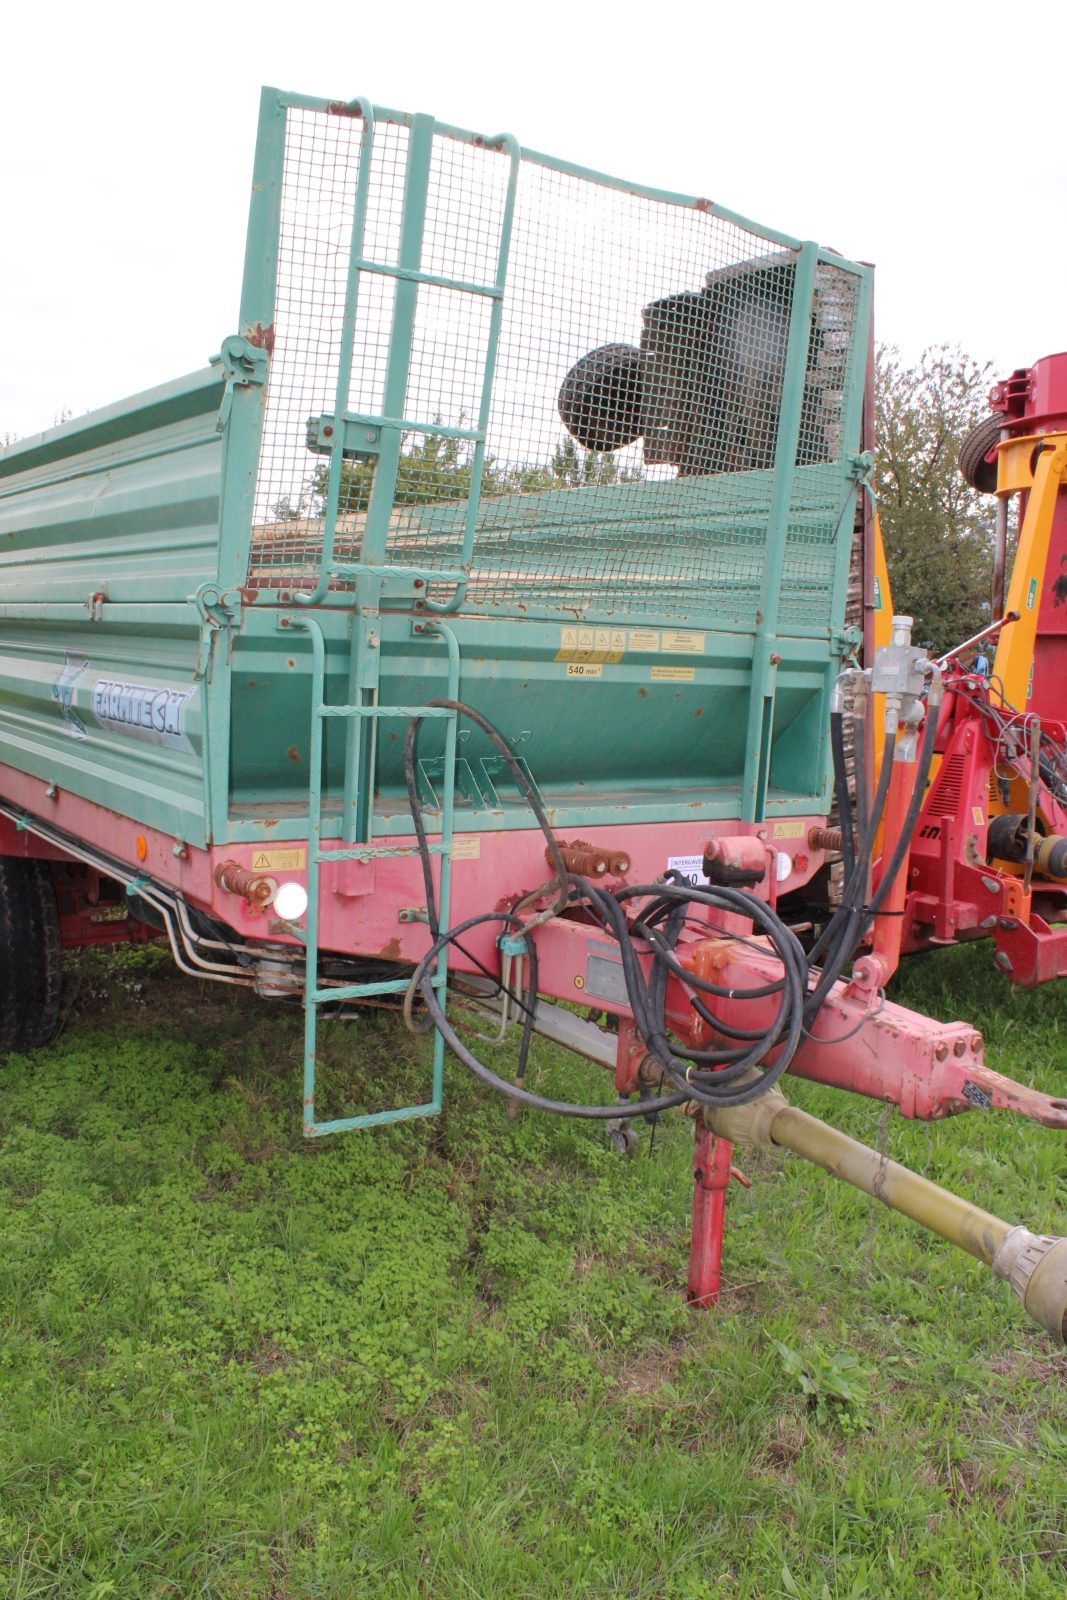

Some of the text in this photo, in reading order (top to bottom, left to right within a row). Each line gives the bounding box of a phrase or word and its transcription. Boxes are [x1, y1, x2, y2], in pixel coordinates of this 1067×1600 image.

[568, 665, 584, 675] 540
[93, 680, 187, 736] FARMTECH
[919, 825, 942, 840] in
[672, 858, 703, 866] INTERGAVE
